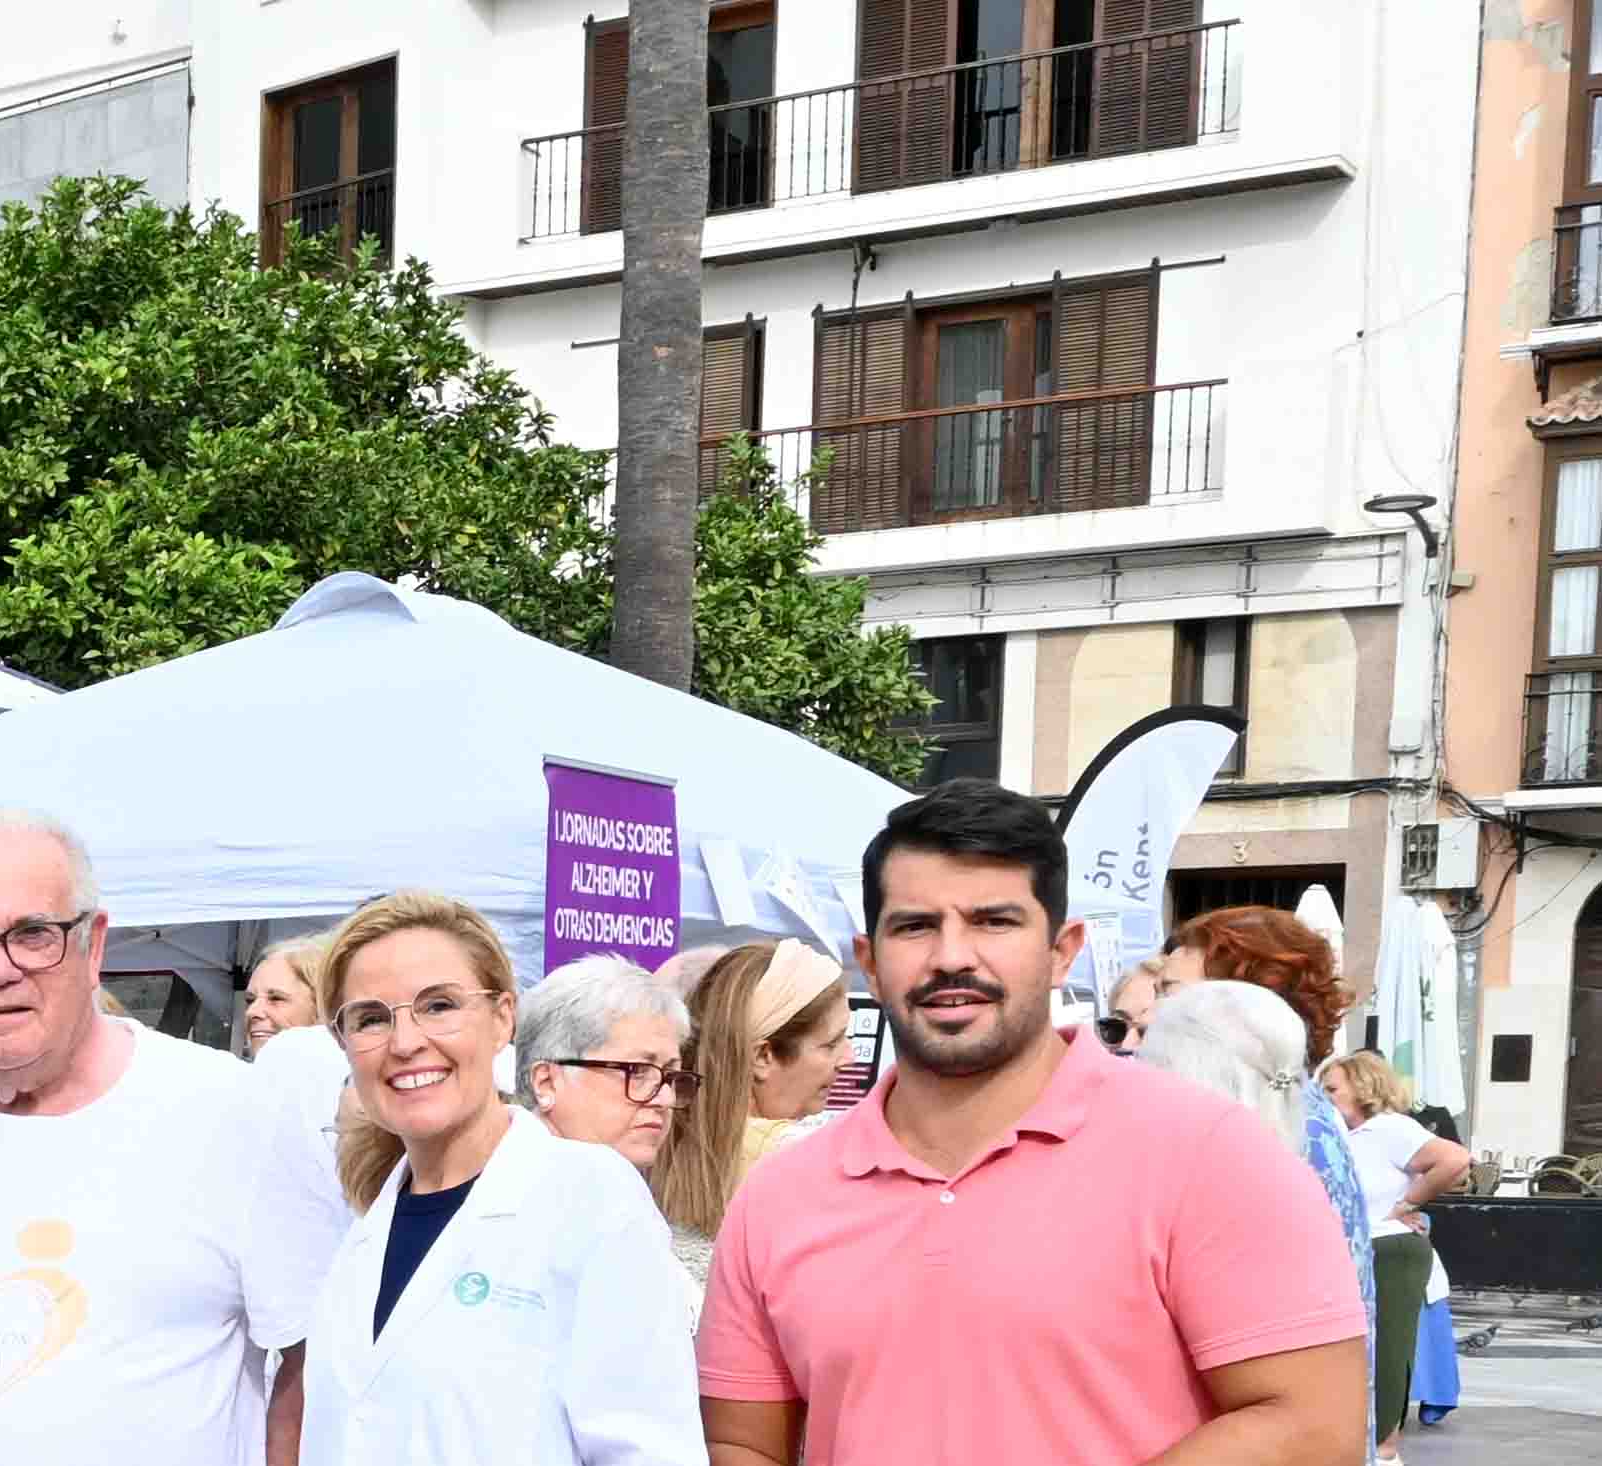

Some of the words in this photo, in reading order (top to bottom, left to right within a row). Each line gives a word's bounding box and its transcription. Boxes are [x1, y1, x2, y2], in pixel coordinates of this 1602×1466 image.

[560, 810, 626, 851] JORNADAS
[627, 822, 673, 857] SOBRE
[1233, 839, 1250, 864] 3
[571, 861, 640, 900] ALZHEIMER
[643, 870, 653, 900] Y
[554, 907, 593, 943] OTRAS
[595, 911, 674, 948] DEMENCIAS
